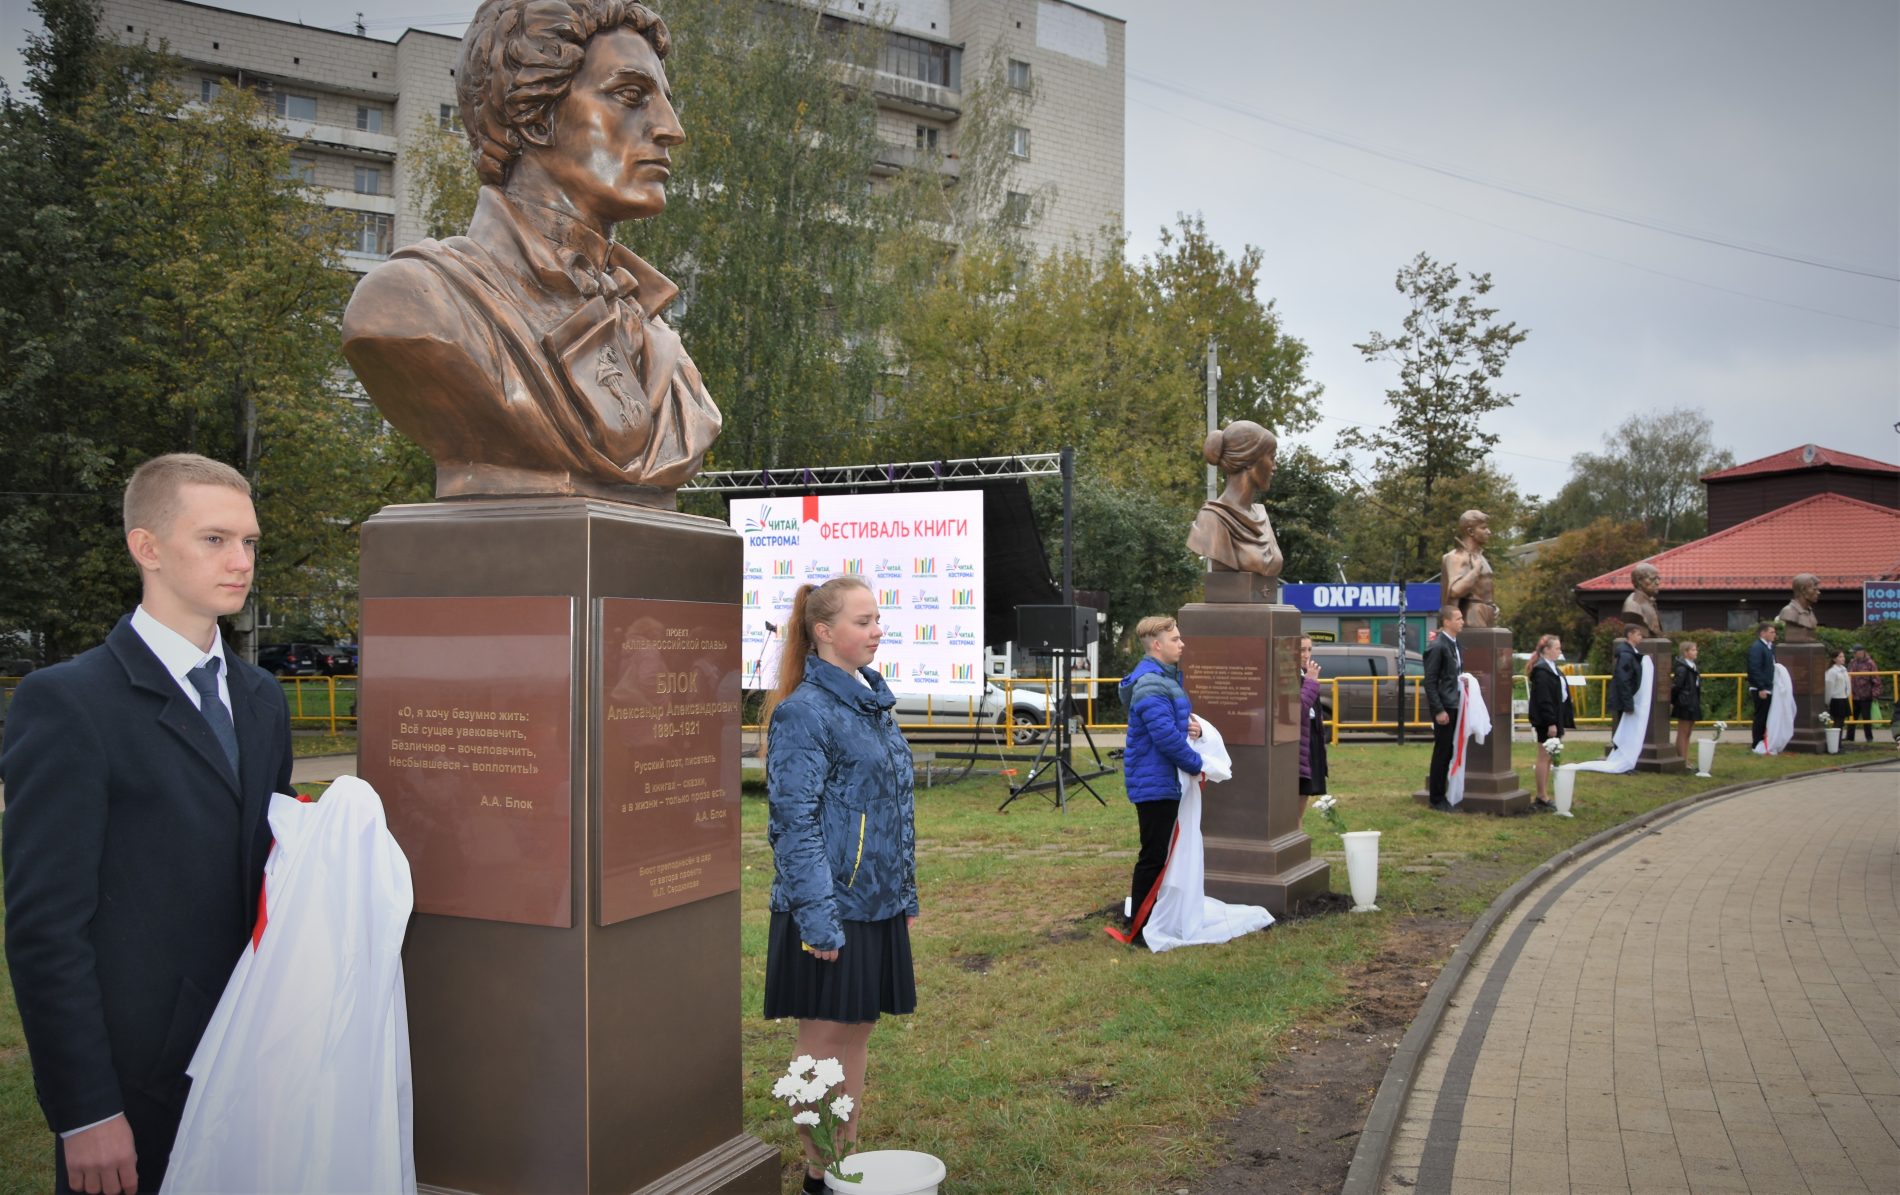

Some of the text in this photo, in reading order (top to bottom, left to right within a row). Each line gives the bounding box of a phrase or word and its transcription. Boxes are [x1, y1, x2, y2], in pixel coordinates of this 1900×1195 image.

[768, 518, 799, 532] ЧИТАЙ,
[820, 519, 967, 541] ФЕСТИВАЛЬ КНИГИ
[750, 535, 799, 547] КОСТРОМА!
[1313, 586, 1408, 607] ОХРАНА
[656, 672, 698, 694] БЛОК
[416, 709, 424, 717] я
[425, 709, 450, 721] хочу
[452, 707, 497, 722] безумно
[499, 712, 530, 722] жить:
[608, 702, 738, 720] Александр Александрович
[400, 723, 527, 740] Всё сущее увековечить,
[391, 739, 447, 752] Безличное
[457, 744, 537, 758] вочеловечить,
[389, 756, 461, 770] Несбывшееся
[472, 762, 539, 774] воплотить!»
[634, 758, 664, 774] Русский
[685, 753, 717, 765] писатель
[480, 796, 533, 809] А.А. Блок
